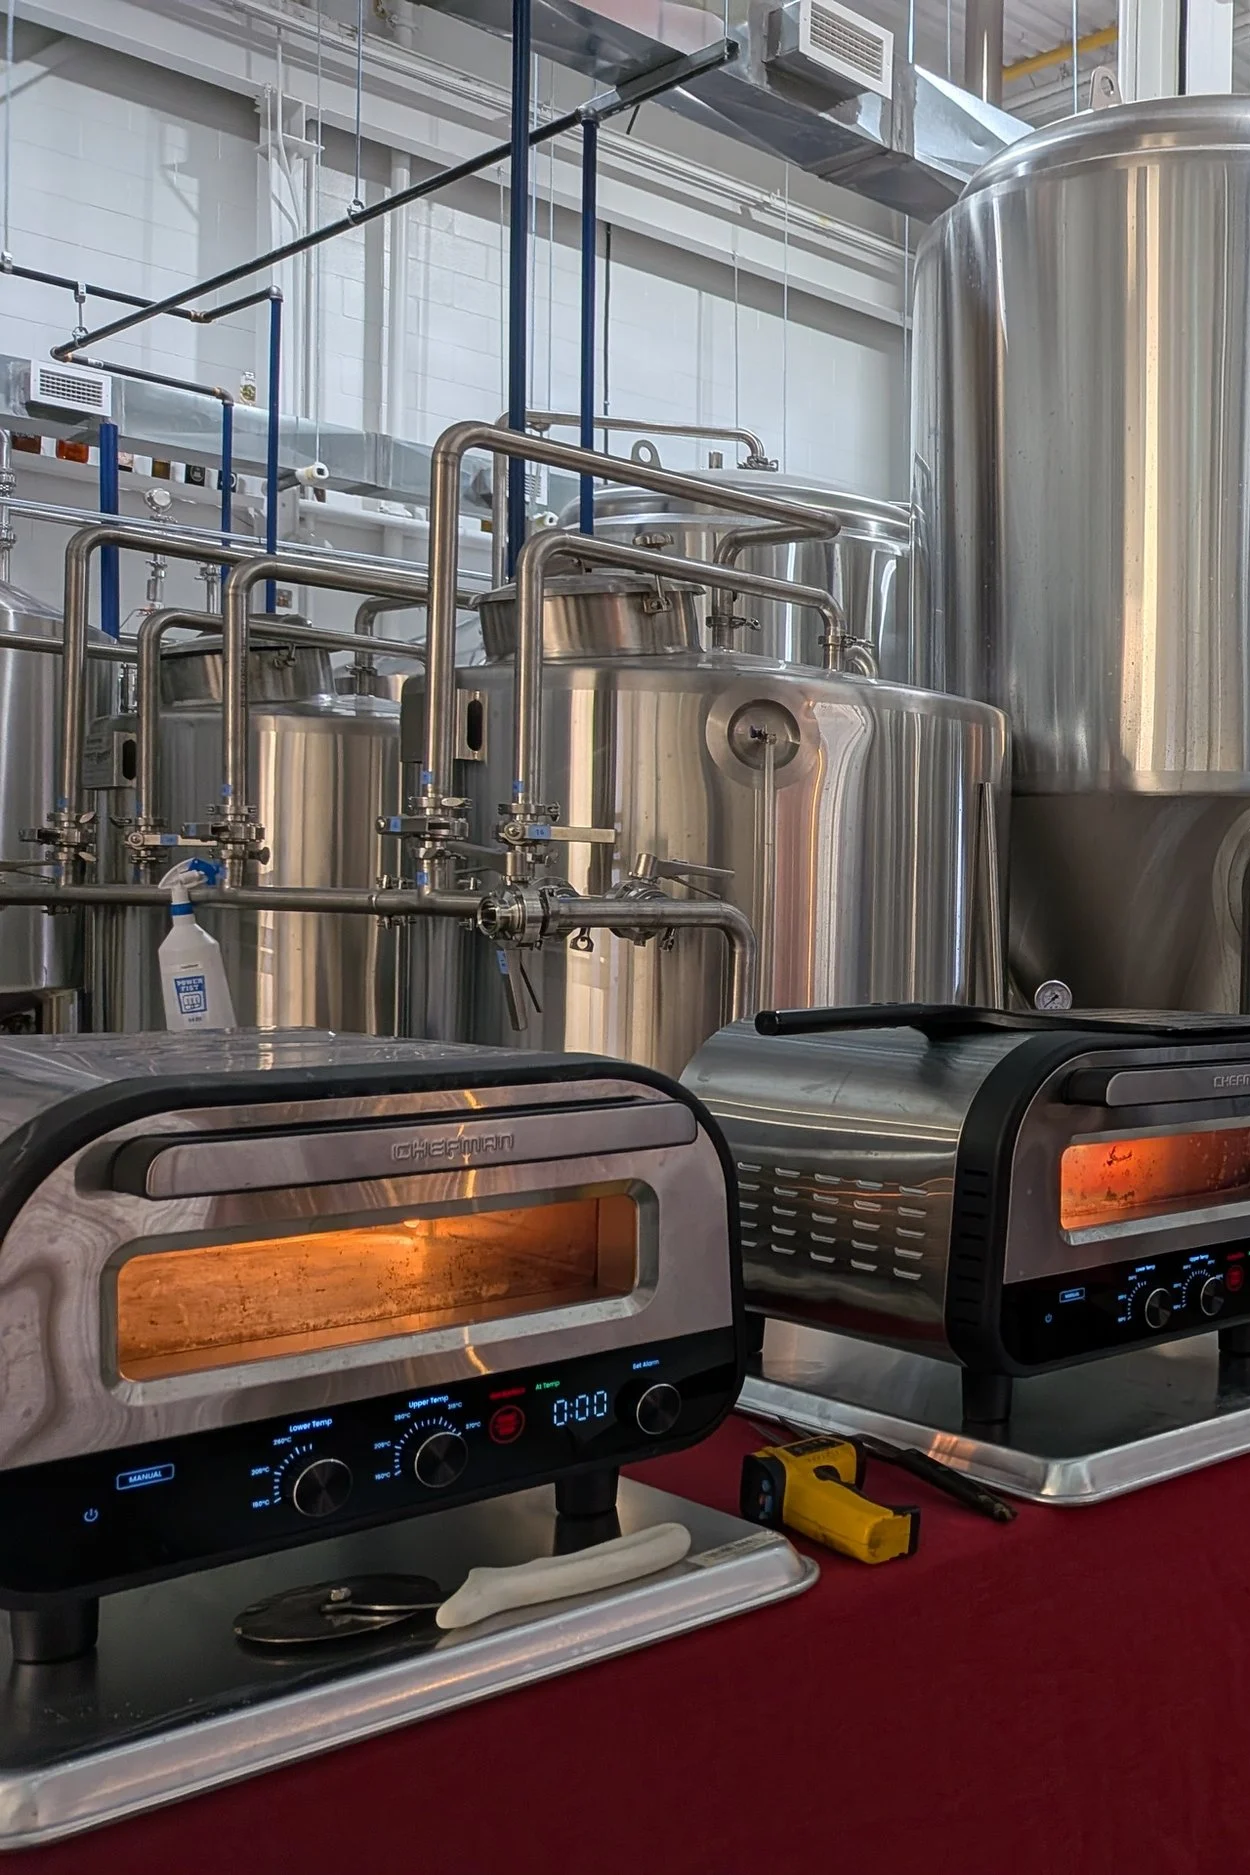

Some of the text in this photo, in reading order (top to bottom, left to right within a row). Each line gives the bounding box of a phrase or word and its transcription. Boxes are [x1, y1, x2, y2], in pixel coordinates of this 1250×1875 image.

[391, 1132, 515, 1161] CHEFMAN
[543, 1380, 561, 1389] Temp
[408, 1394, 450, 1410] Upper Temp
[553, 1390, 607, 1427] 0:00
[289, 1418, 333, 1433] Lower Temp
[128, 1470, 163, 1484] MANUAL
